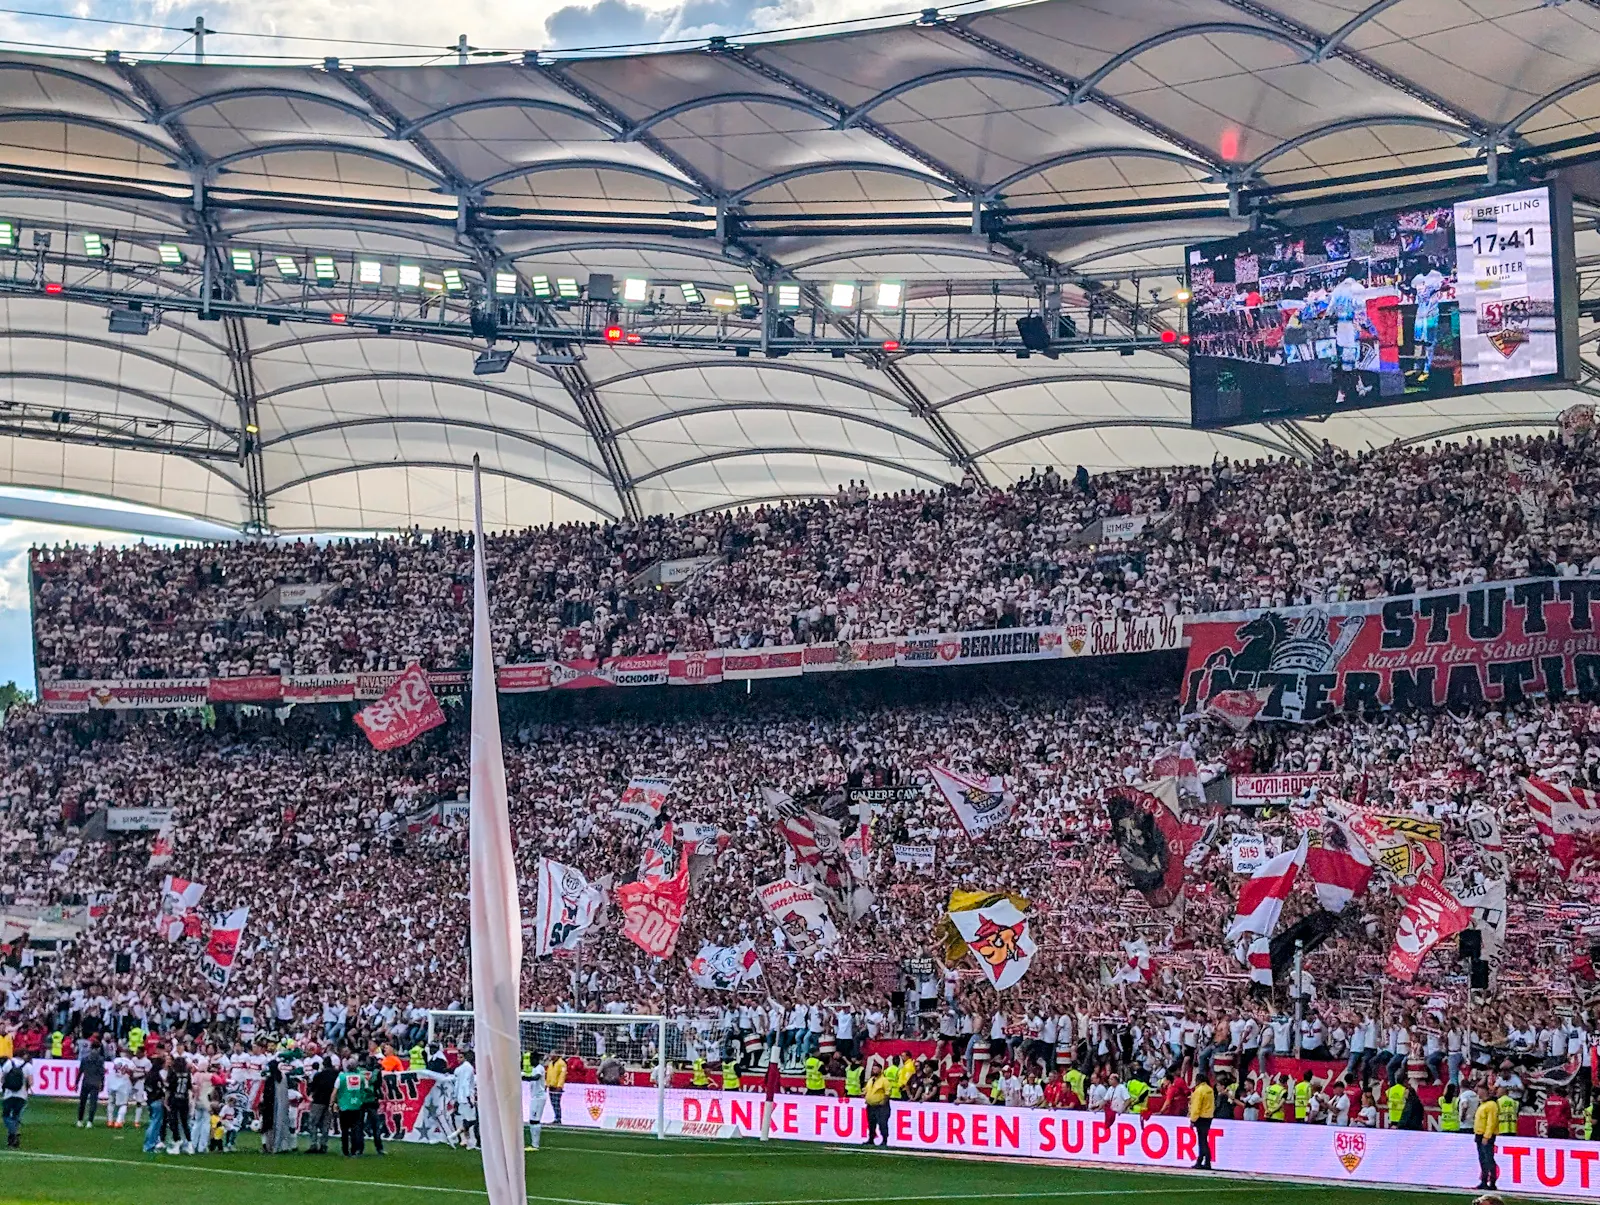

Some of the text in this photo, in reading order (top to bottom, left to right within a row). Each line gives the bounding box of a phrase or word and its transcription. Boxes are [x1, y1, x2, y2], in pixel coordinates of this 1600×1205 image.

[1477, 199, 1541, 218] BREITLING
[1473, 227, 1535, 255] 17:41
[1485, 261, 1523, 277] KUTTER
[959, 631, 1041, 659] BERKHEIM
[1091, 614, 1177, 655] Red Hots 96
[1362, 652, 1409, 669] Nach
[1410, 646, 1436, 664] all
[1441, 646, 1477, 663] der
[1480, 634, 1559, 660] Scheiße
[683, 1097, 798, 1133] DANKE
[896, 1109, 1020, 1149] EUREN
[1039, 1116, 1224, 1163] SUPPORT
[1488, 1145, 1600, 1189] TUT
